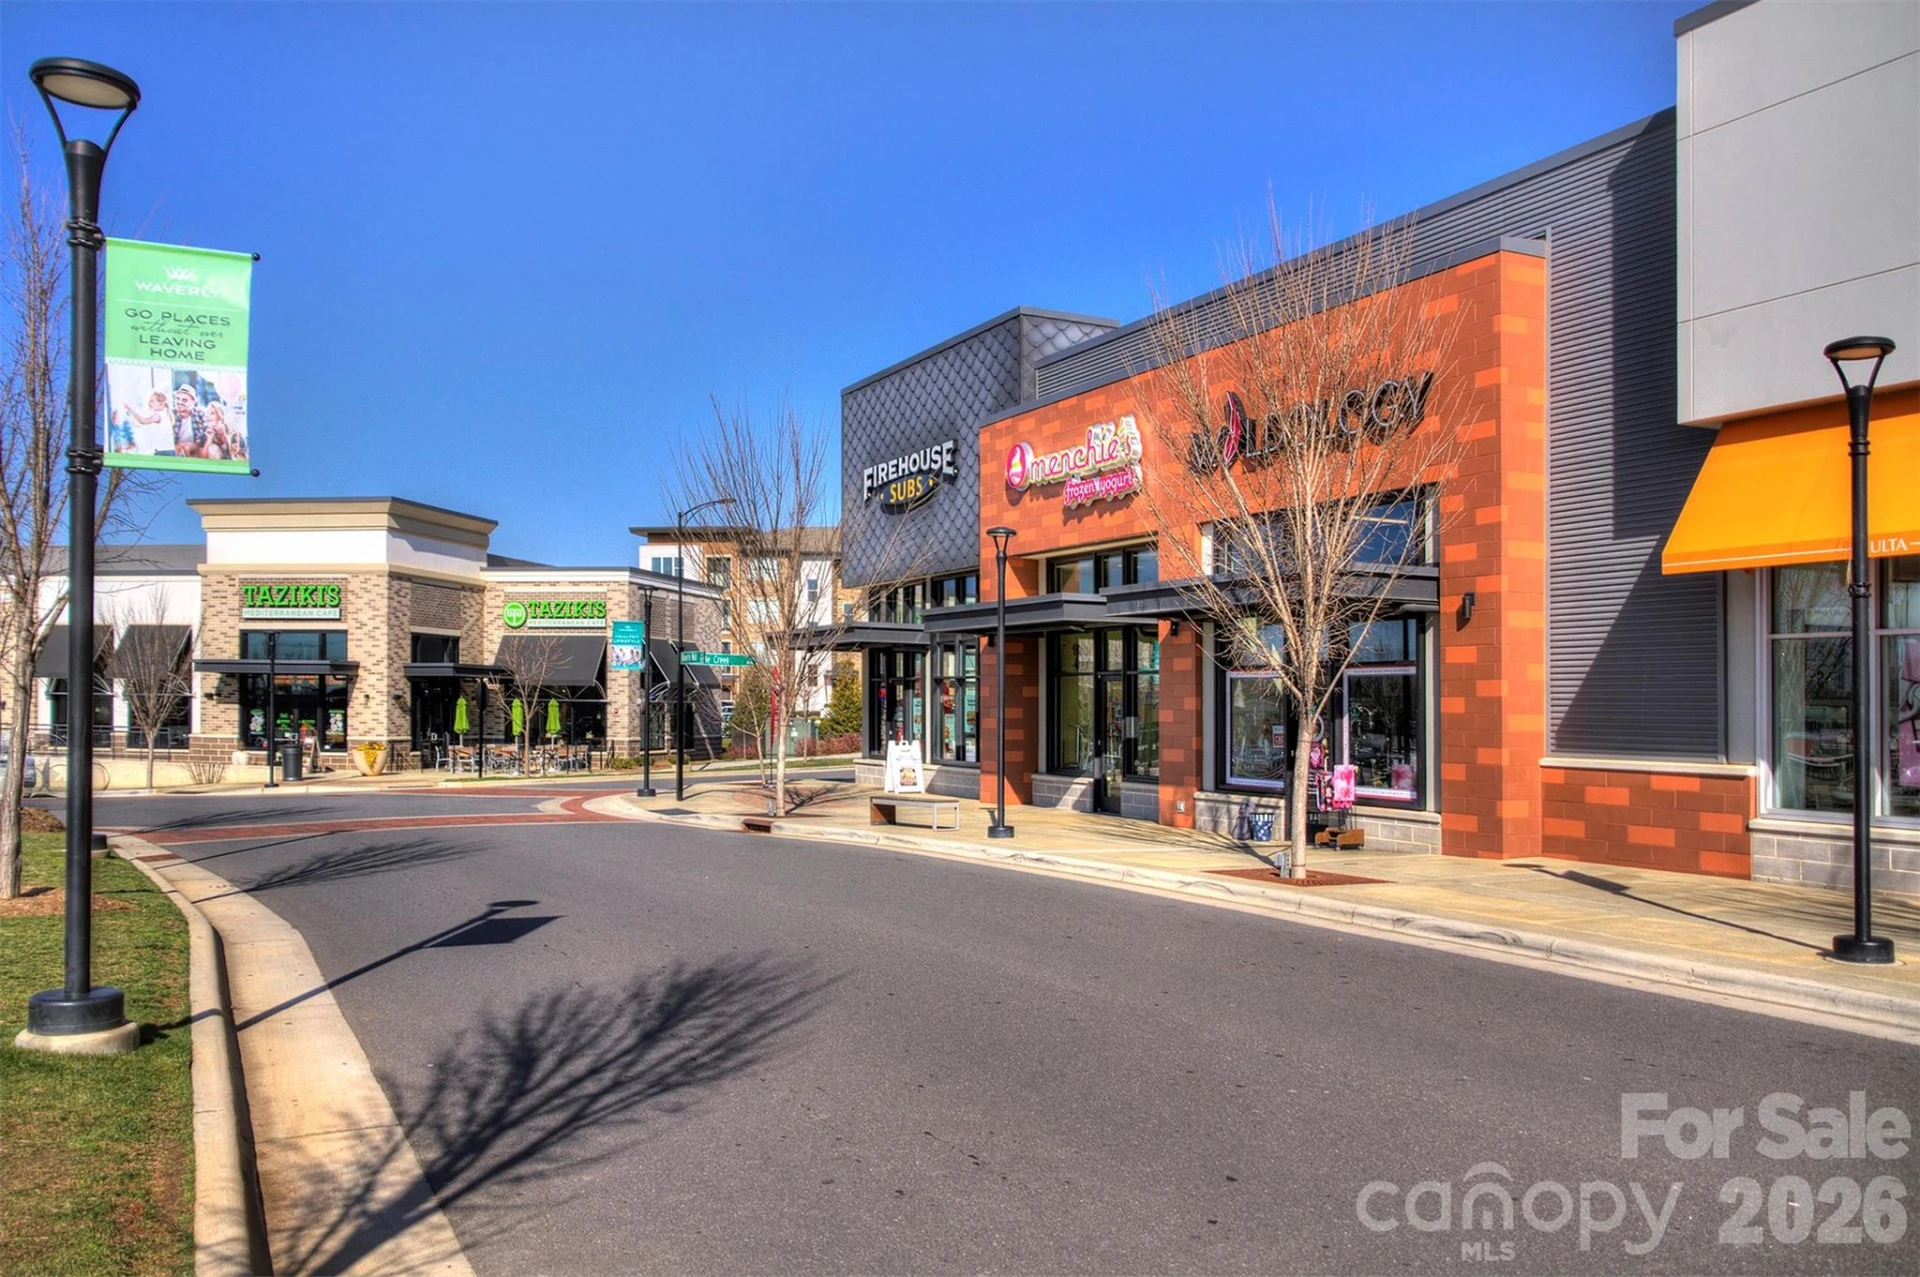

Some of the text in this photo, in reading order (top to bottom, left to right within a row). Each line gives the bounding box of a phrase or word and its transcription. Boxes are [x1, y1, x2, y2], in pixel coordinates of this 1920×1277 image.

[135, 280, 222, 298] WAVERLY
[124, 308, 231, 327] GO PLACES
[131, 319, 200, 336] without
[138, 335, 217, 350] LEAVING
[149, 347, 206, 362] HOME
[863, 440, 954, 501] FIREHOUSE
[889, 475, 924, 504] SUBS
[1064, 466, 1134, 505] frozen yogurt
[1869, 537, 1909, 554] ULTA
[241, 584, 341, 607] TAZIKI'S
[244, 609, 314, 617] MEDITERRANEAN
[712, 655, 730, 665] Creek
